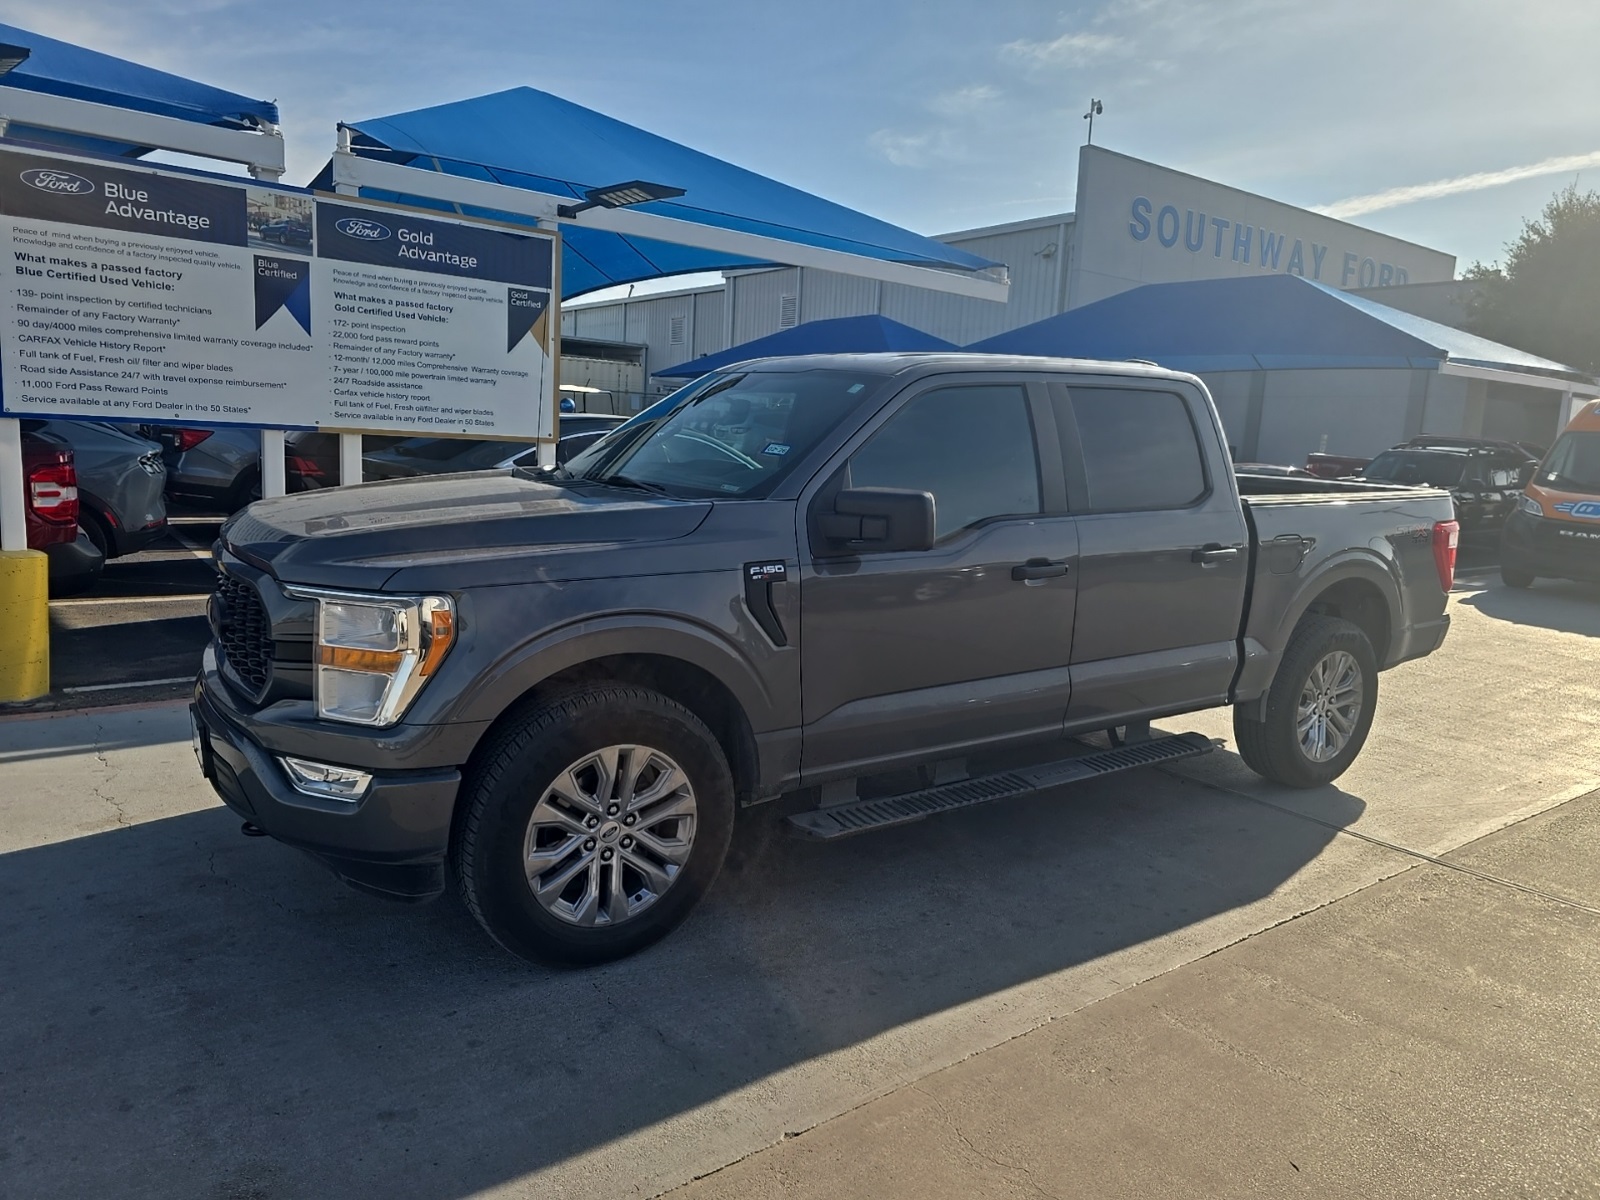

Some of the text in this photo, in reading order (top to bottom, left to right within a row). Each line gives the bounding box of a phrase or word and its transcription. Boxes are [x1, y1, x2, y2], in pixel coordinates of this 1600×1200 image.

[35, 172, 80, 192] Ford
[104, 182, 148, 202] Blue
[105, 201, 210, 230] Advantage
[346, 221, 380, 238] Ford
[398, 228, 433, 246] Gold
[1129, 196, 1328, 280] SOUTHWAY
[12, 226, 38, 236] Peace
[52, 232, 71, 240] mind
[73, 234, 93, 242] when
[95, 236, 120, 247] buying
[128, 241, 164, 252] previously
[166, 246, 193, 256] enjoyed
[195, 250, 220, 258] vehicle.
[13, 236, 56, 248] Knowledge
[75, 244, 116, 254] confidence
[133, 250, 157, 260] factory
[258, 260, 278, 268] Blue
[398, 245, 477, 268] Advantage
[14, 252, 46, 264] What
[50, 256, 88, 268] makes
[101, 263, 142, 274] passed
[145, 266, 182, 280] factory
[258, 268, 297, 280] Certified
[16, 266, 174, 291] Blue Certified Used Vehicle:
[66, 293, 112, 304] inspection
[114, 298, 126, 308] by
[128, 301, 162, 310] certified
[164, 304, 212, 315] technicians
[334, 291, 356, 301] What
[358, 295, 386, 304] makes
[396, 300, 424, 308] passed
[426, 302, 453, 313] factory
[510, 298, 540, 308] Certified
[511, 291, 528, 300] Gold
[17, 304, 69, 316] Remainder
[83, 312, 100, 320] any
[102, 312, 136, 323] Factory
[334, 304, 448, 323] Gold Certified Used Vehicle:
[32, 320, 76, 331] day/4000
[78, 326, 102, 334] miles
[104, 328, 172, 340] comprehensive
[174, 332, 200, 342] limited
[203, 336, 238, 346] warranty
[240, 340, 276, 349] coverage
[370, 322, 406, 332] inspection
[18, 334, 61, 344] CARFAX
[64, 338, 97, 348] Vehicle
[100, 342, 131, 352] History
[333, 330, 358, 340] 22,000
[360, 333, 374, 341] ford
[419, 340, 440, 348] points
[334, 342, 372, 352] Remainder
[398, 348, 422, 358] Factory
[20, 350, 36, 358] Full
[99, 355, 124, 364] Fresh
[182, 362, 204, 370] wiper
[206, 364, 234, 372] blades
[372, 358, 395, 366] 12,000
[417, 362, 468, 372] Comprehensive
[471, 366, 500, 376] Warranty
[20, 364, 46, 374] Road
[48, 366, 68, 374] side
[70, 368, 118, 378] Assistance
[122, 371, 140, 379] 24/7
[162, 374, 186, 382] travel
[188, 377, 223, 385] expense
[352, 378, 385, 387] Roadside
[366, 368, 394, 376] 100,000
[411, 373, 446, 382] powertrain
[56, 382, 76, 390] Ford
[80, 383, 102, 392] Pass
[104, 384, 138, 394] Reward
[142, 387, 168, 395] Points
[386, 392, 408, 401] history
[22, 394, 56, 404] Service
[60, 397, 100, 406] available
[132, 400, 152, 408] Ford
[156, 402, 183, 410] Dealer
